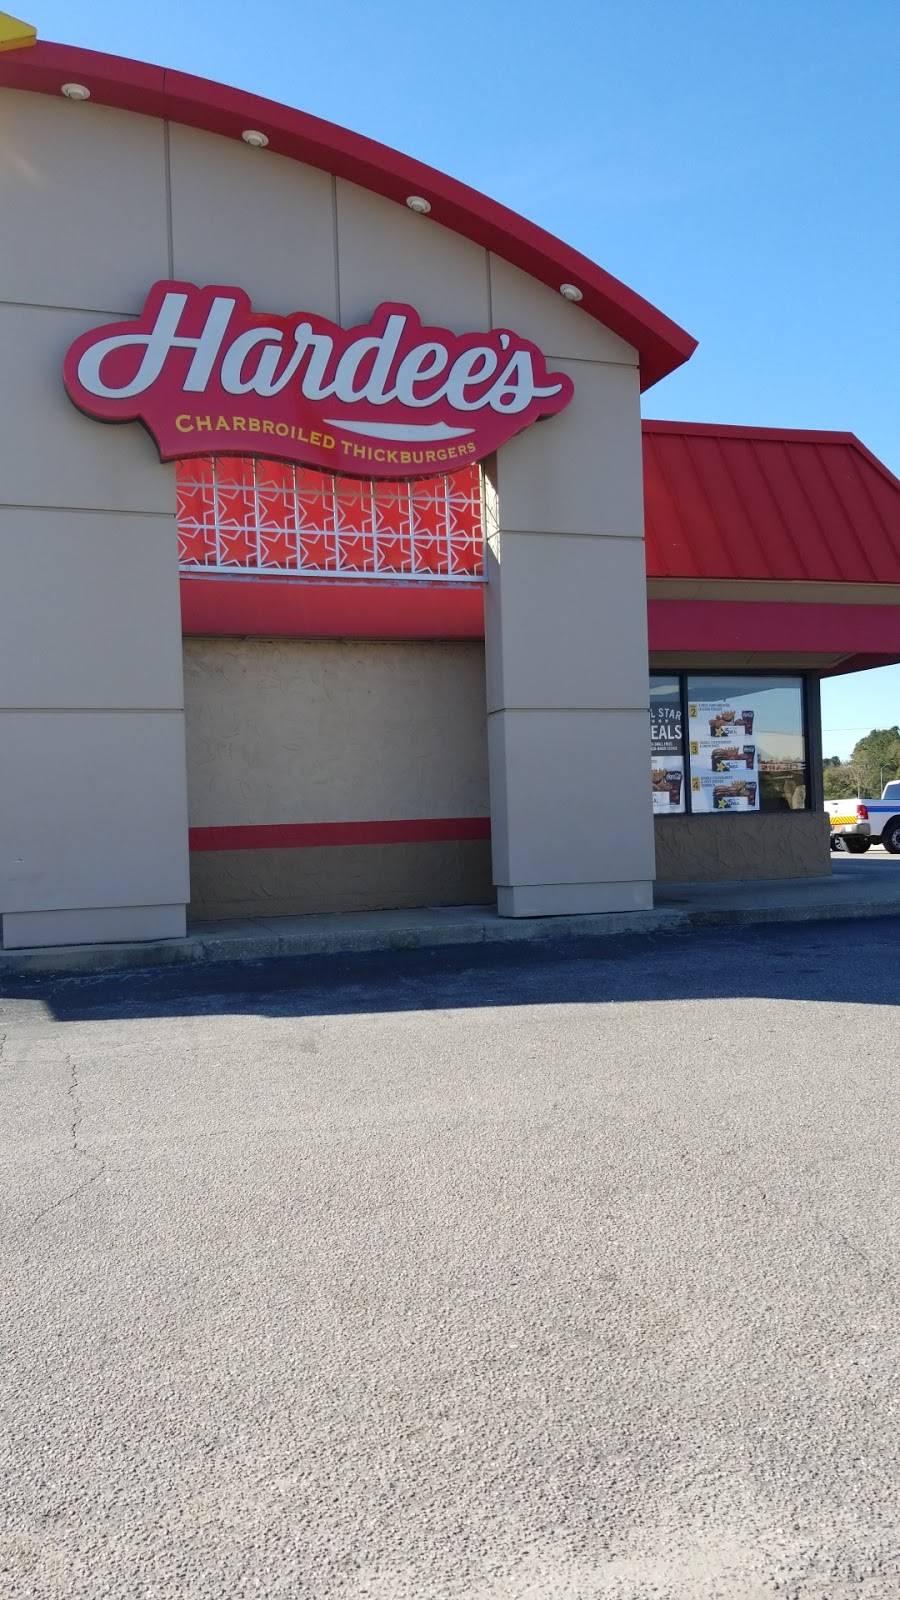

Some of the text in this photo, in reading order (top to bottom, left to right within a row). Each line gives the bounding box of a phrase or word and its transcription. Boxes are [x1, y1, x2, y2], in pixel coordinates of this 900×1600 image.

[77, 293, 563, 414] Hardee's
[175, 414, 476, 464] CHARBROILED THICKBURGERS
[658, 707, 682, 720] STAR
[651, 724, 683, 740] EALS
